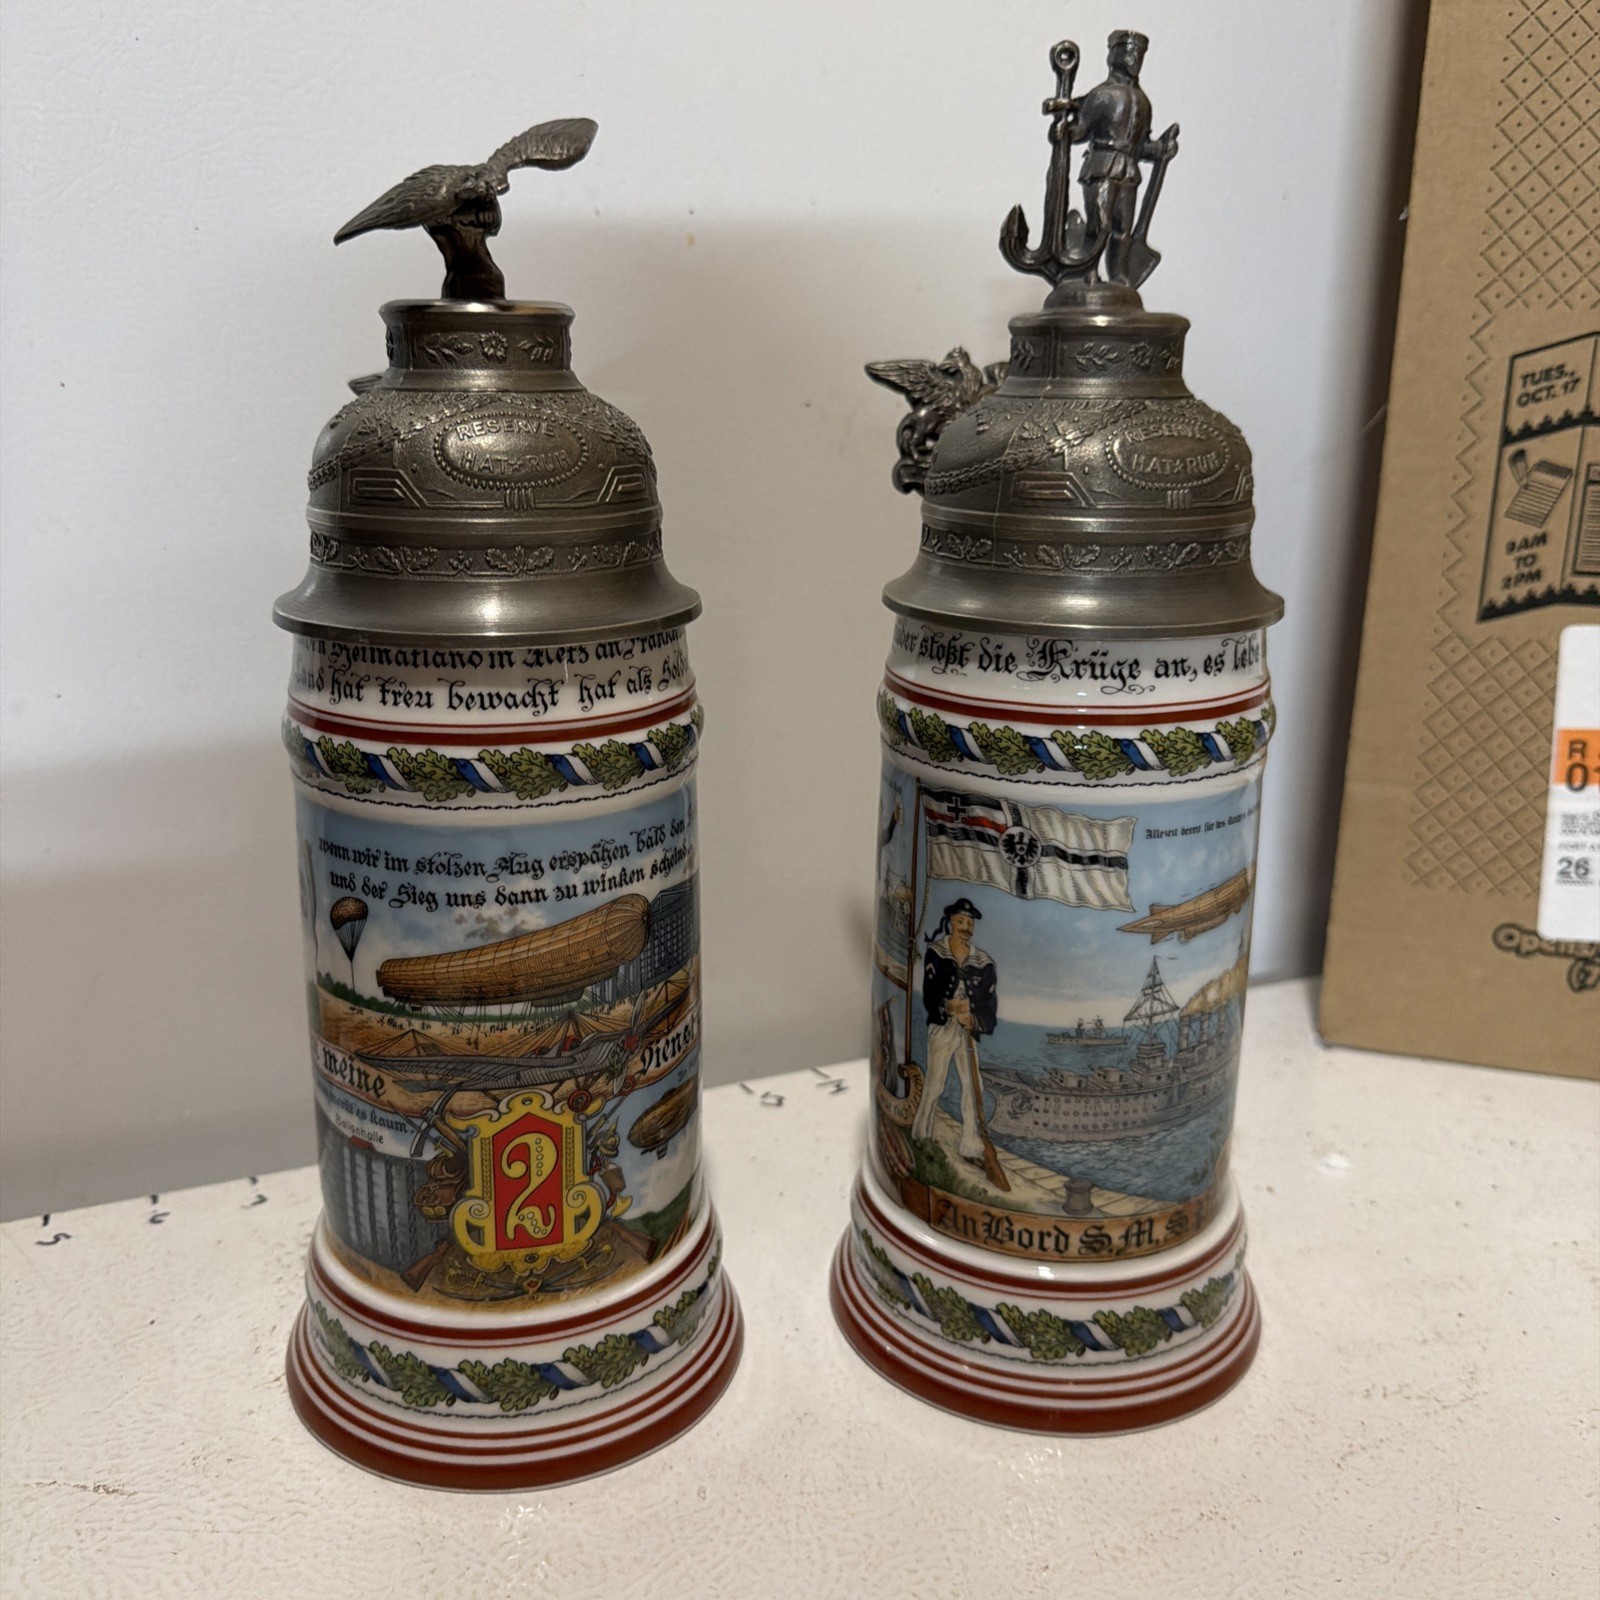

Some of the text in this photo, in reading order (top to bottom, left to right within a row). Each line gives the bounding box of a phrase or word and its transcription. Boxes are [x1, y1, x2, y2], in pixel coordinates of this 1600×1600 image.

[1516, 377, 1581, 408] OCT. 17
[455, 418, 556, 440] RESERVE
[1125, 422, 1208, 444] RESERVE
[1513, 553, 1537, 570] TO
[977, 637, 1020, 674] die
[1154, 656, 1198, 682] an,
[1203, 653, 1226, 677] es
[375, 676, 434, 710] treu
[436, 677, 564, 717] bewacht
[574, 670, 622, 712] hat
[627, 666, 653, 694] als
[319, 838, 350, 862] wenn
[384, 851, 410, 873] im
[413, 852, 488, 879] stolzen
[1557, 856, 1590, 879] 26
[330, 870, 357, 893] und
[361, 876, 388, 900] der
[445, 889, 488, 909] uns
[494, 885, 550, 908] dann
[554, 883, 579, 902] zu
[323, 1046, 386, 1098] meine
[501, 1131, 559, 1241] 2
[982, 1210, 1070, 1254] Bord
